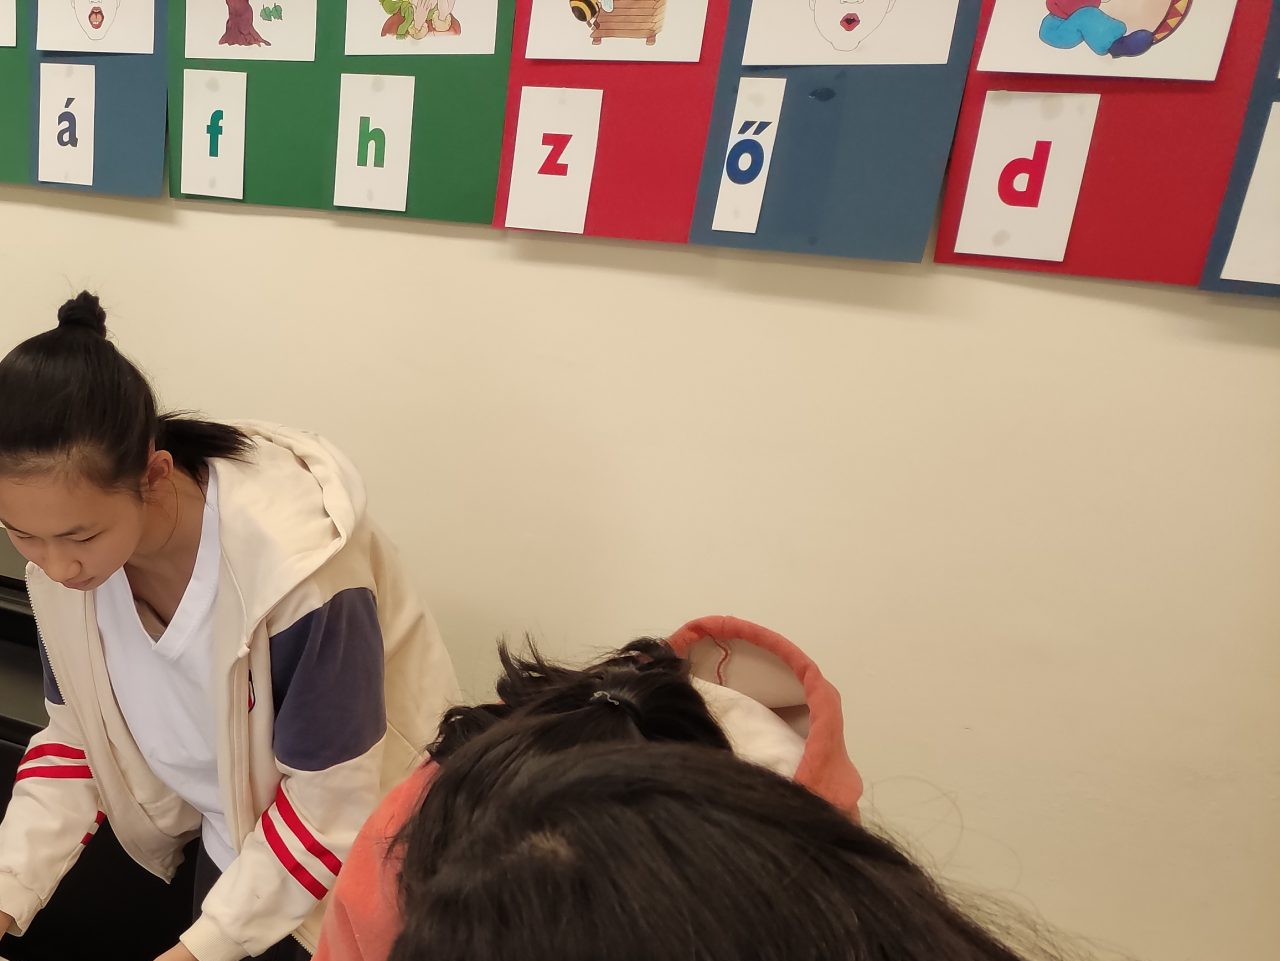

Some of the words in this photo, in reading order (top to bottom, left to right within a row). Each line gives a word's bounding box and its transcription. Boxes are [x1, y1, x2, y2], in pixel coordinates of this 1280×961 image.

[56, 98, 78, 147] á
[206, 110, 223, 158] f
[357, 116, 386, 168] h
[537, 132, 573, 176] z
[725, 120, 773, 185] ő
[998, 141, 1052, 208] d
